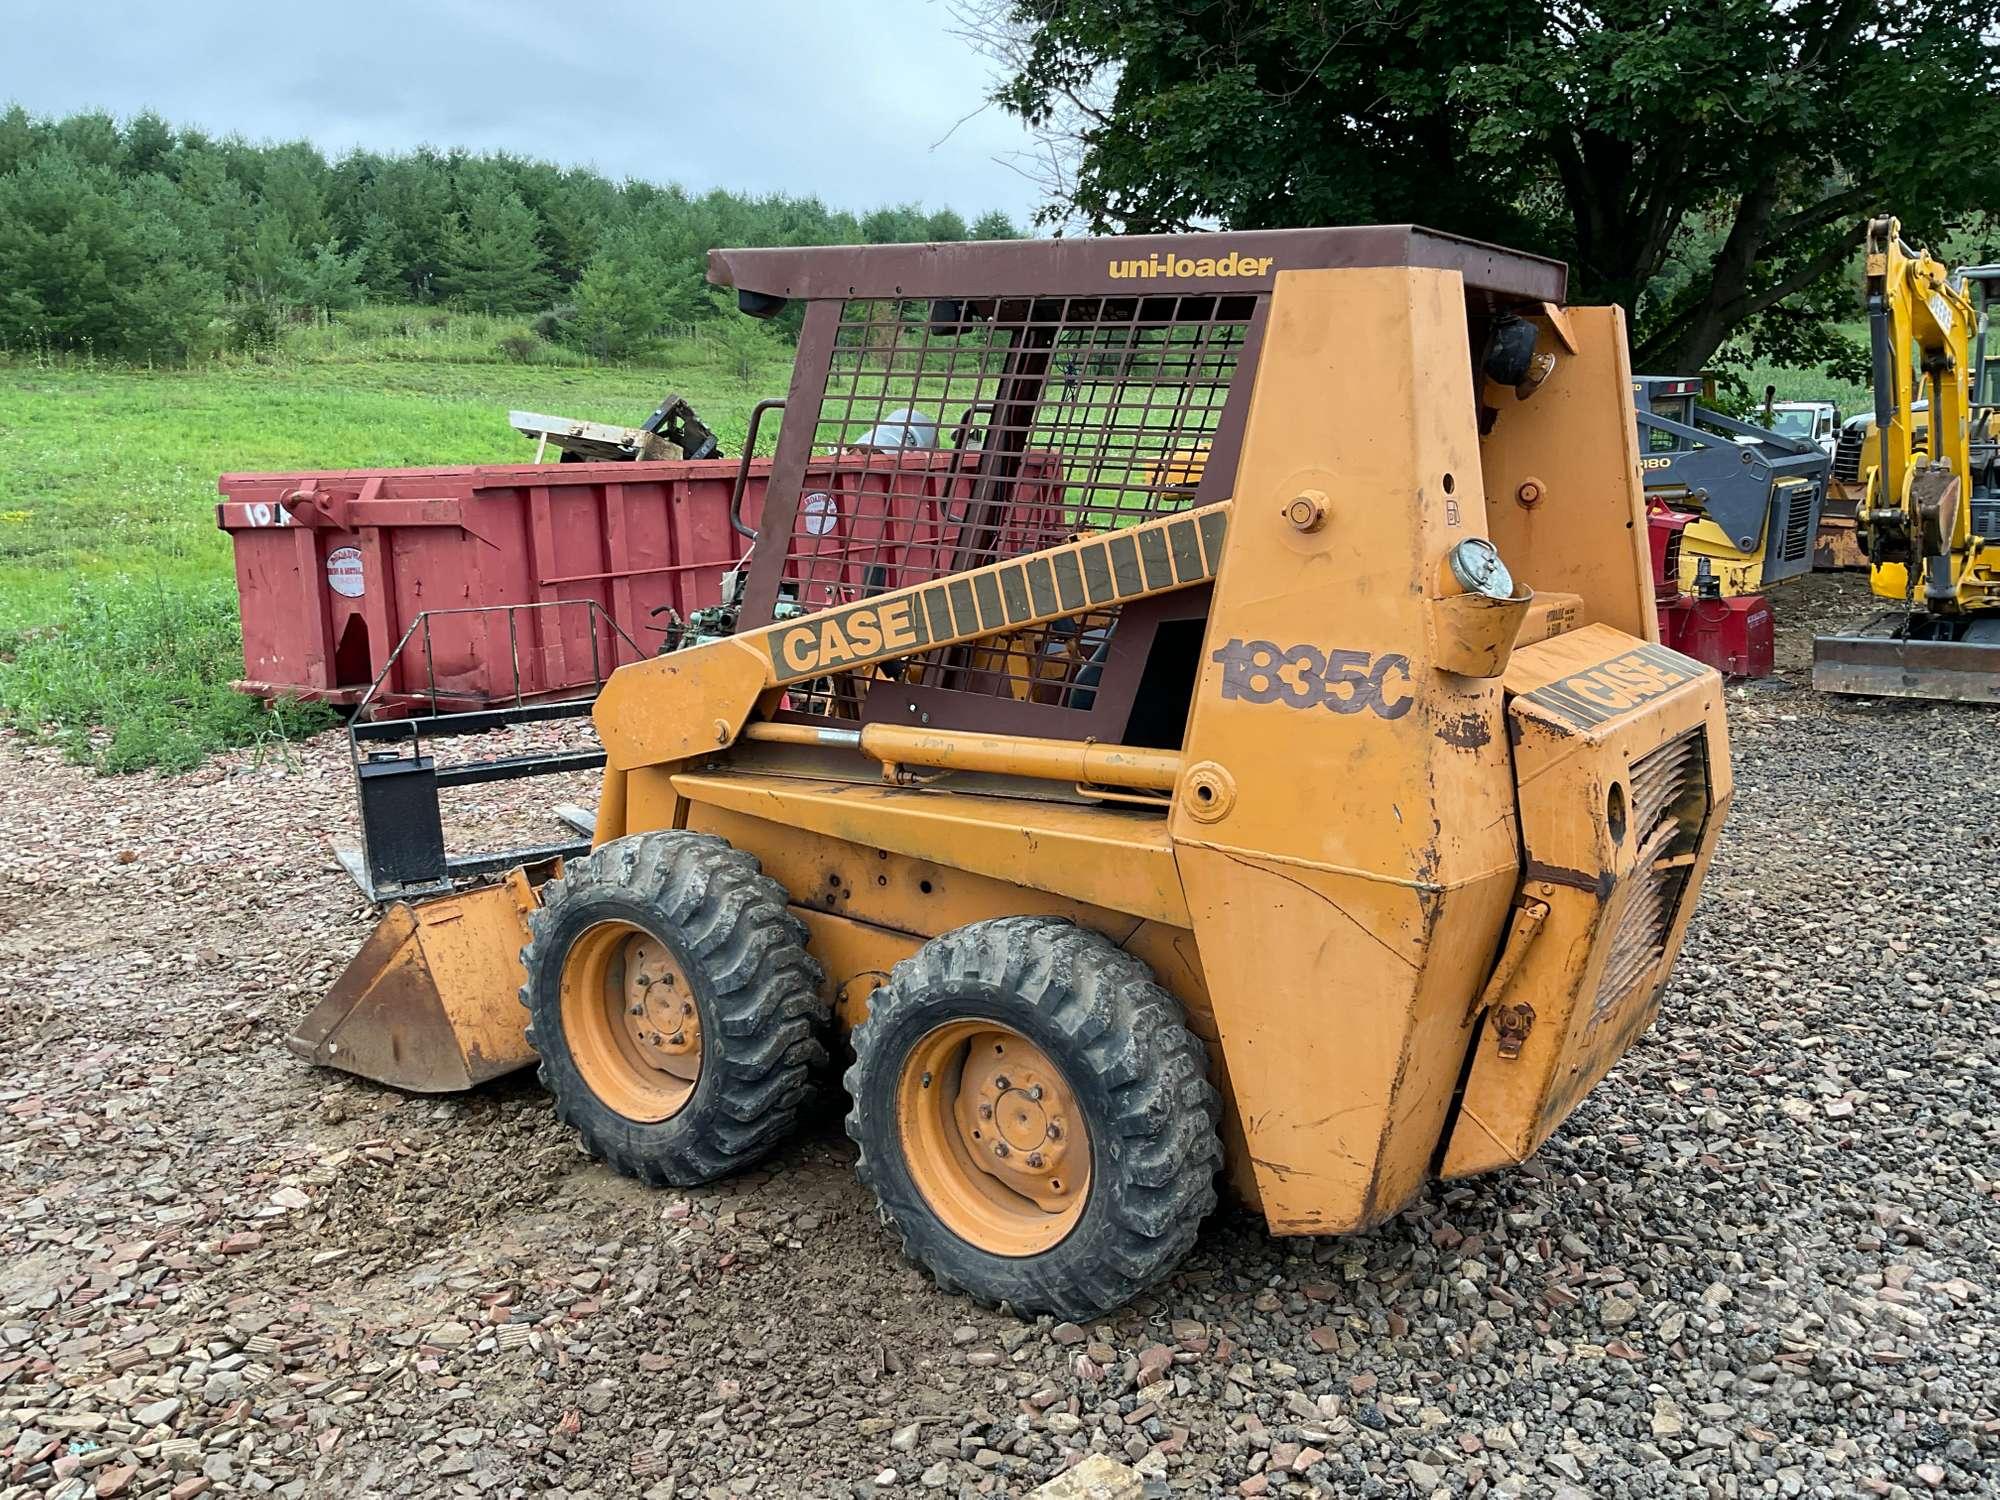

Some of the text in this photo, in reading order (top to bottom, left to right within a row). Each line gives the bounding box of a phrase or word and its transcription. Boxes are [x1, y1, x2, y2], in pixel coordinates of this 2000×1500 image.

[1109, 251, 1273, 279] uni-loader
[783, 600, 917, 672] CASE
[1212, 638, 1414, 720] 1835C
[1566, 655, 1684, 709] CASE
